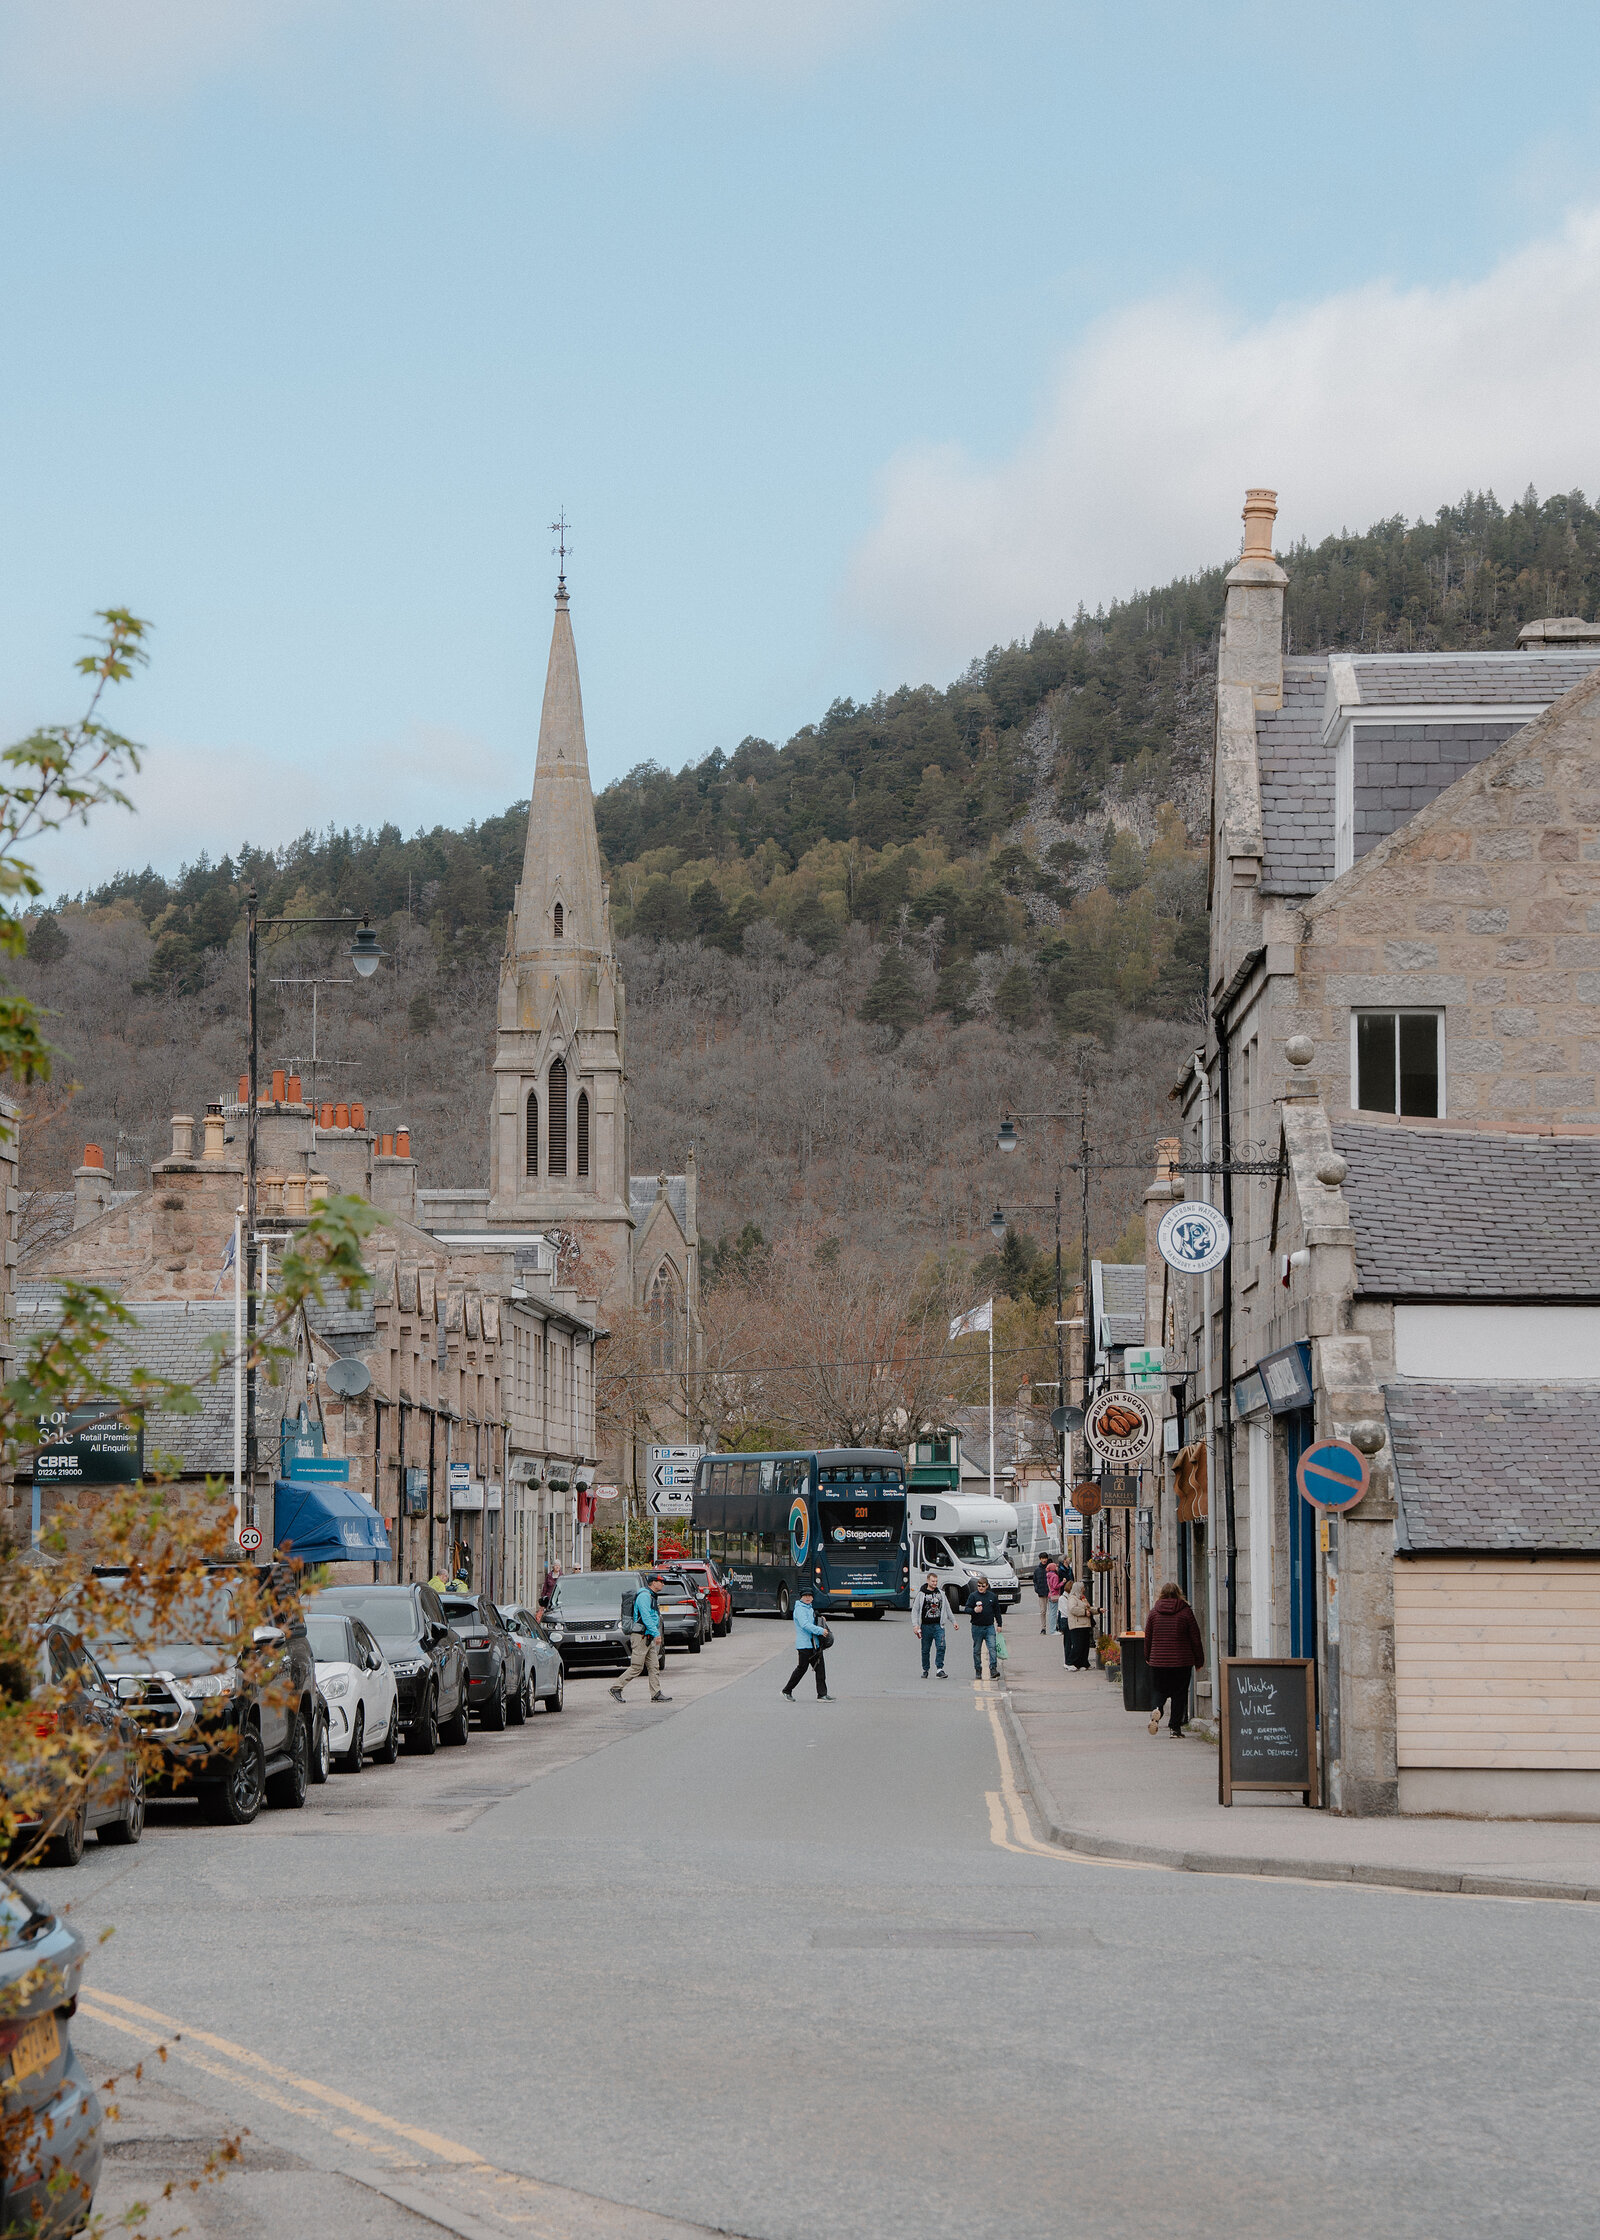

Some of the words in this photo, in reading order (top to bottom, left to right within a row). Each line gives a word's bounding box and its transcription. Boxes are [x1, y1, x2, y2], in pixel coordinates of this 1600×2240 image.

[1164, 1217, 1173, 1228] THE
[1172, 1205, 1196, 1217] STRONG
[1198, 1206, 1218, 1220] WATER
[1166, 1249, 1191, 1268] BANCHORY
[1197, 1250, 1221, 1268] BALLATER
[1094, 1394, 1120, 1415] BROWN
[1122, 1395, 1146, 1415] SUGAR
[90, 1444, 101, 1452] All
[1096, 1438, 1147, 1458] BALLATER
[1111, 1439, 1131, 1447] CAFE
[37, 1456, 79, 1467] CBRE
[855, 1507, 868, 1518] 201
[242, 1534, 259, 1544] 20
[846, 1530, 890, 1540] Stagecoach
[1236, 1677, 1278, 1699] Whisky
[1239, 1700, 1276, 1716] WINE
[1242, 1749, 1264, 1757] LOCAL
